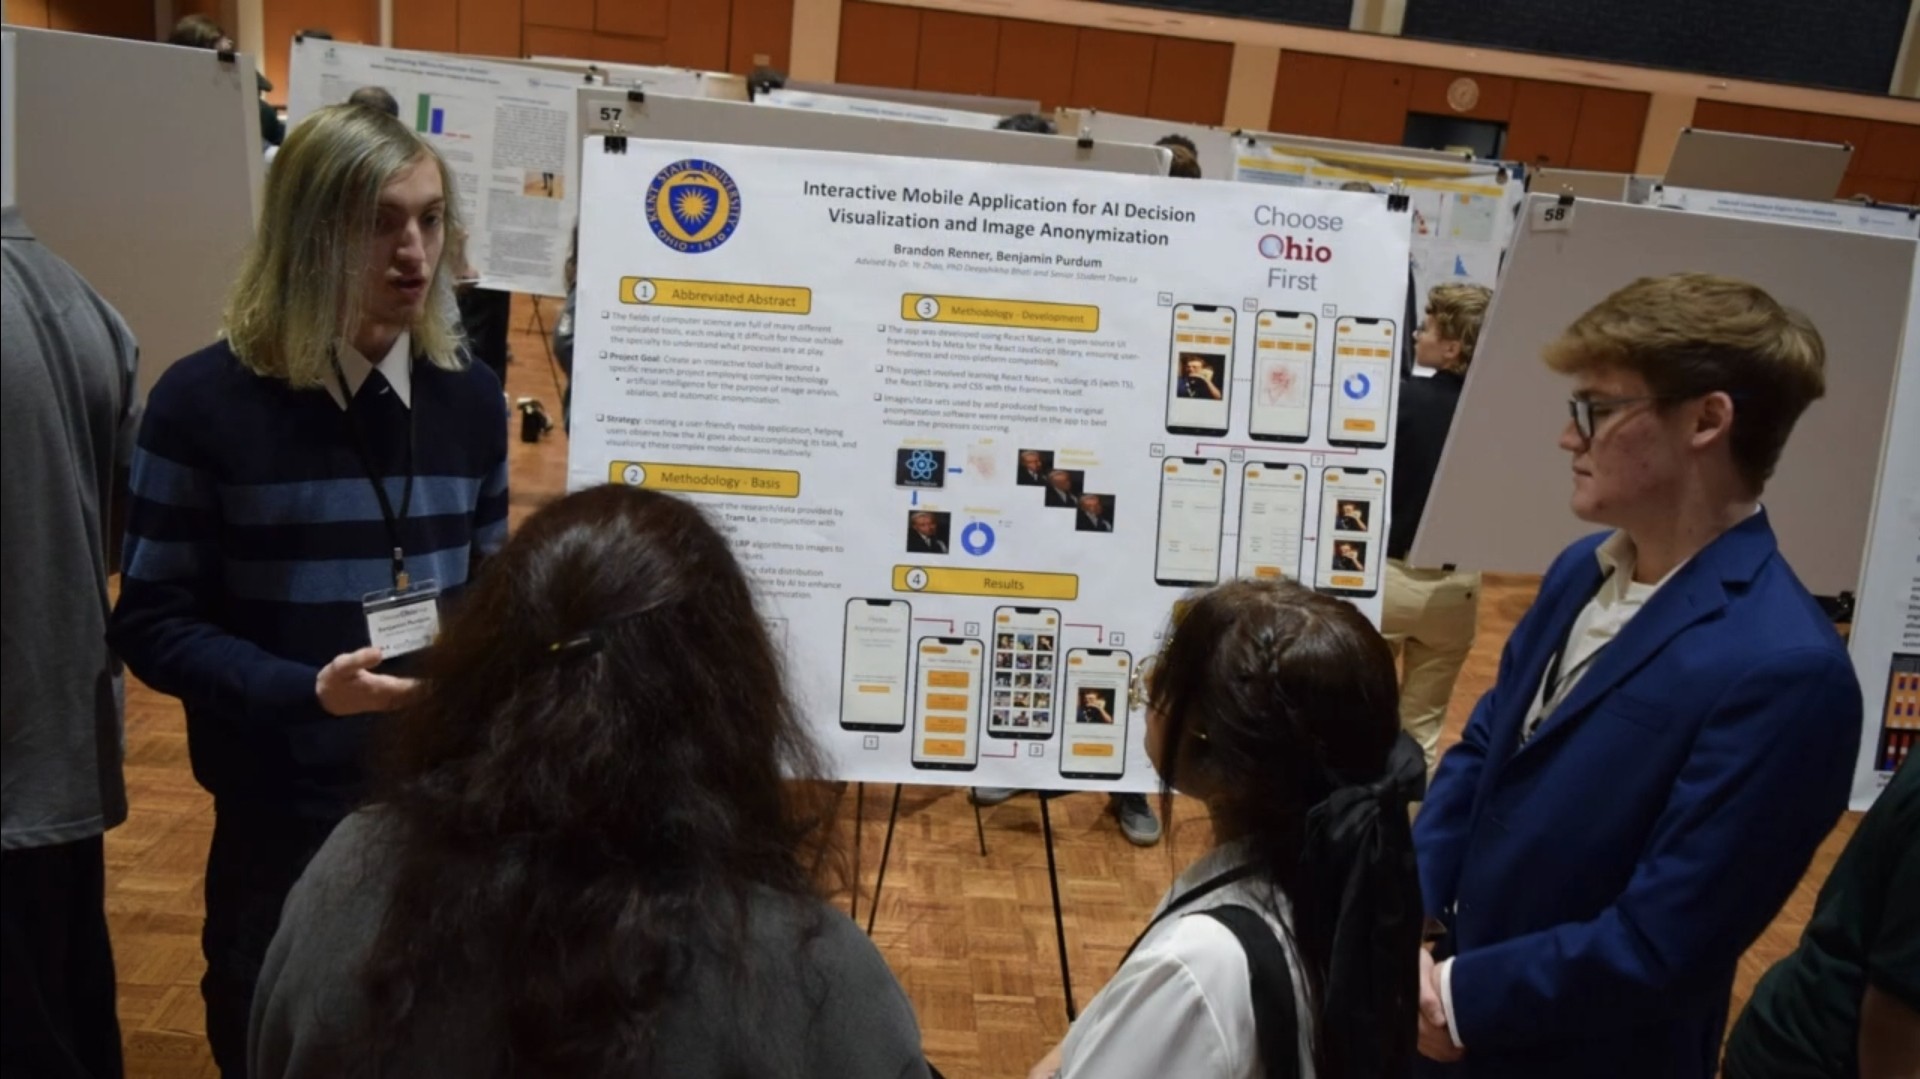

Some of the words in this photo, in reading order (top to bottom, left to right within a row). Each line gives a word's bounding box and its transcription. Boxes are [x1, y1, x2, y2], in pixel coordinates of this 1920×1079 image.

[600, 108, 622, 120] 57
[646, 189, 658, 222] KENT
[658, 162, 692, 182] STATE
[702, 162, 740, 226] UNIVERSITY
[804, 180, 897, 201] Interactive
[902, 187, 963, 206] Mobile
[968, 192, 1067, 216] Application
[1072, 200, 1095, 215] for
[1101, 202, 1119, 217] AI
[1124, 203, 1195, 222] Decision
[1254, 204, 1343, 232] Choose
[1545, 208, 1564, 221] 58
[829, 208, 939, 229] Visualization
[944, 216, 977, 232] and
[982, 219, 1035, 239] Image
[1040, 223, 1168, 248] Anonymization
[658, 230, 688, 251] OHIO
[699, 234, 726, 251] 1910
[1258, 234, 1332, 262] Ohio
[894, 243, 944, 257] Brandon
[947, 247, 993, 262] Renner,
[996, 250, 1052, 266] Benjamin
[1055, 254, 1102, 267] Purdum
[1268, 267, 1318, 291] First
[642, 286, 648, 298] 1
[672, 289, 744, 304] Abbreviated
[748, 292, 796, 307] Abstract
[924, 302, 932, 314] 3
[952, 306, 1014, 320] Methodology
[1022, 312, 1084, 324] Development
[630, 470, 638, 481] 2
[661, 472, 740, 489] Methodology
[751, 477, 780, 489] Basis
[912, 573, 920, 585] 4
[984, 578, 1024, 590] Results
